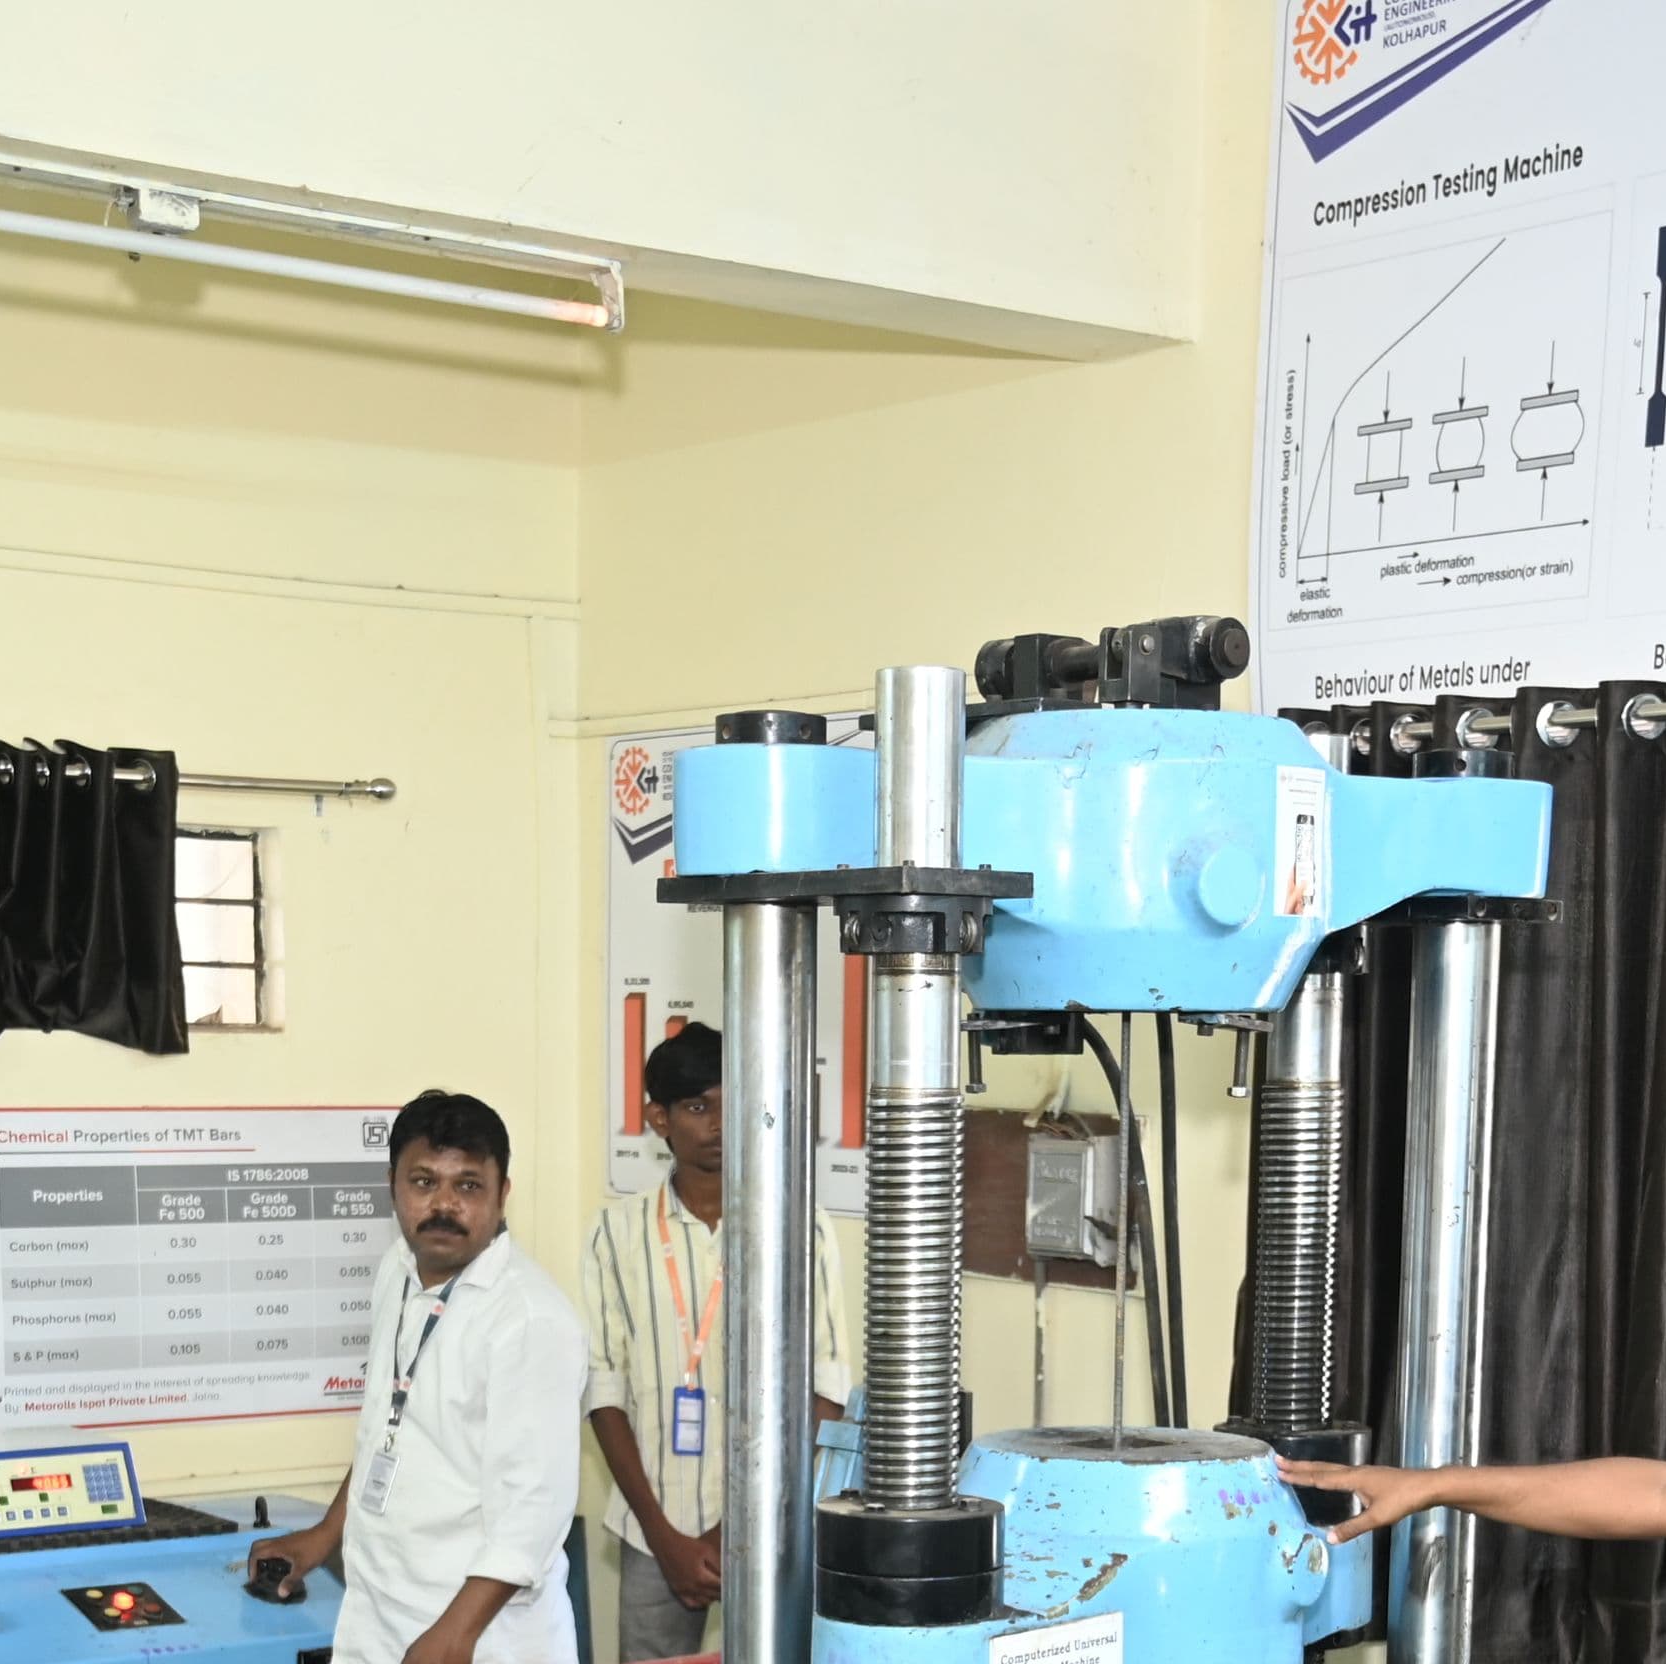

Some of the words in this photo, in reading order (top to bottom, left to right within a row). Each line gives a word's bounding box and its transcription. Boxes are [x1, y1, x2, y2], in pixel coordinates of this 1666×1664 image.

[1383, 20, 1447, 49] KOLHAPUR
[1314, 180, 1426, 226] Compression
[1433, 163, 1498, 197] Testing
[1503, 143, 1584, 184] Machine
[1281, 449, 1290, 477] load
[1277, 481, 1290, 578] compressive
[1380, 560, 1412, 580] plastic
[1414, 554, 1475, 574] deformation
[1299, 586, 1331, 602] elastic
[1287, 605, 1343, 624] deformation
[1315, 669, 1395, 700] Behaviour
[1399, 665, 1415, 692] of
[1419, 660, 1474, 691] Metals
[1480, 656, 1531, 685] under
[73, 1129, 150, 1145] Properties
[154, 1128, 169, 1142] of
[173, 1128, 204, 1142] TMT
[210, 1128, 241, 1142] Bars
[227, 1170, 240, 1182] IS
[32, 1189, 103, 1204] Properties
[161, 1194, 202, 1207] Grade
[250, 1193, 288, 1205] Grade
[335, 1191, 372, 1202] Grade
[159, 1209, 176, 1221] Fe
[243, 1206, 259, 1218] Fe
[332, 1204, 348, 1216] Fe
[9, 1241, 53, 1252] Carbon
[11, 1278, 57, 1290] Sulphur
[167, 1273, 202, 1285] 0.055
[12, 1314, 81, 1327] Phosphorus
[167, 1308, 202, 1320] 0.055
[4, 1385, 42, 1397] Printed
[68, 1381, 120, 1395] displayed
[1074, 1631, 1117, 1651] Universal
